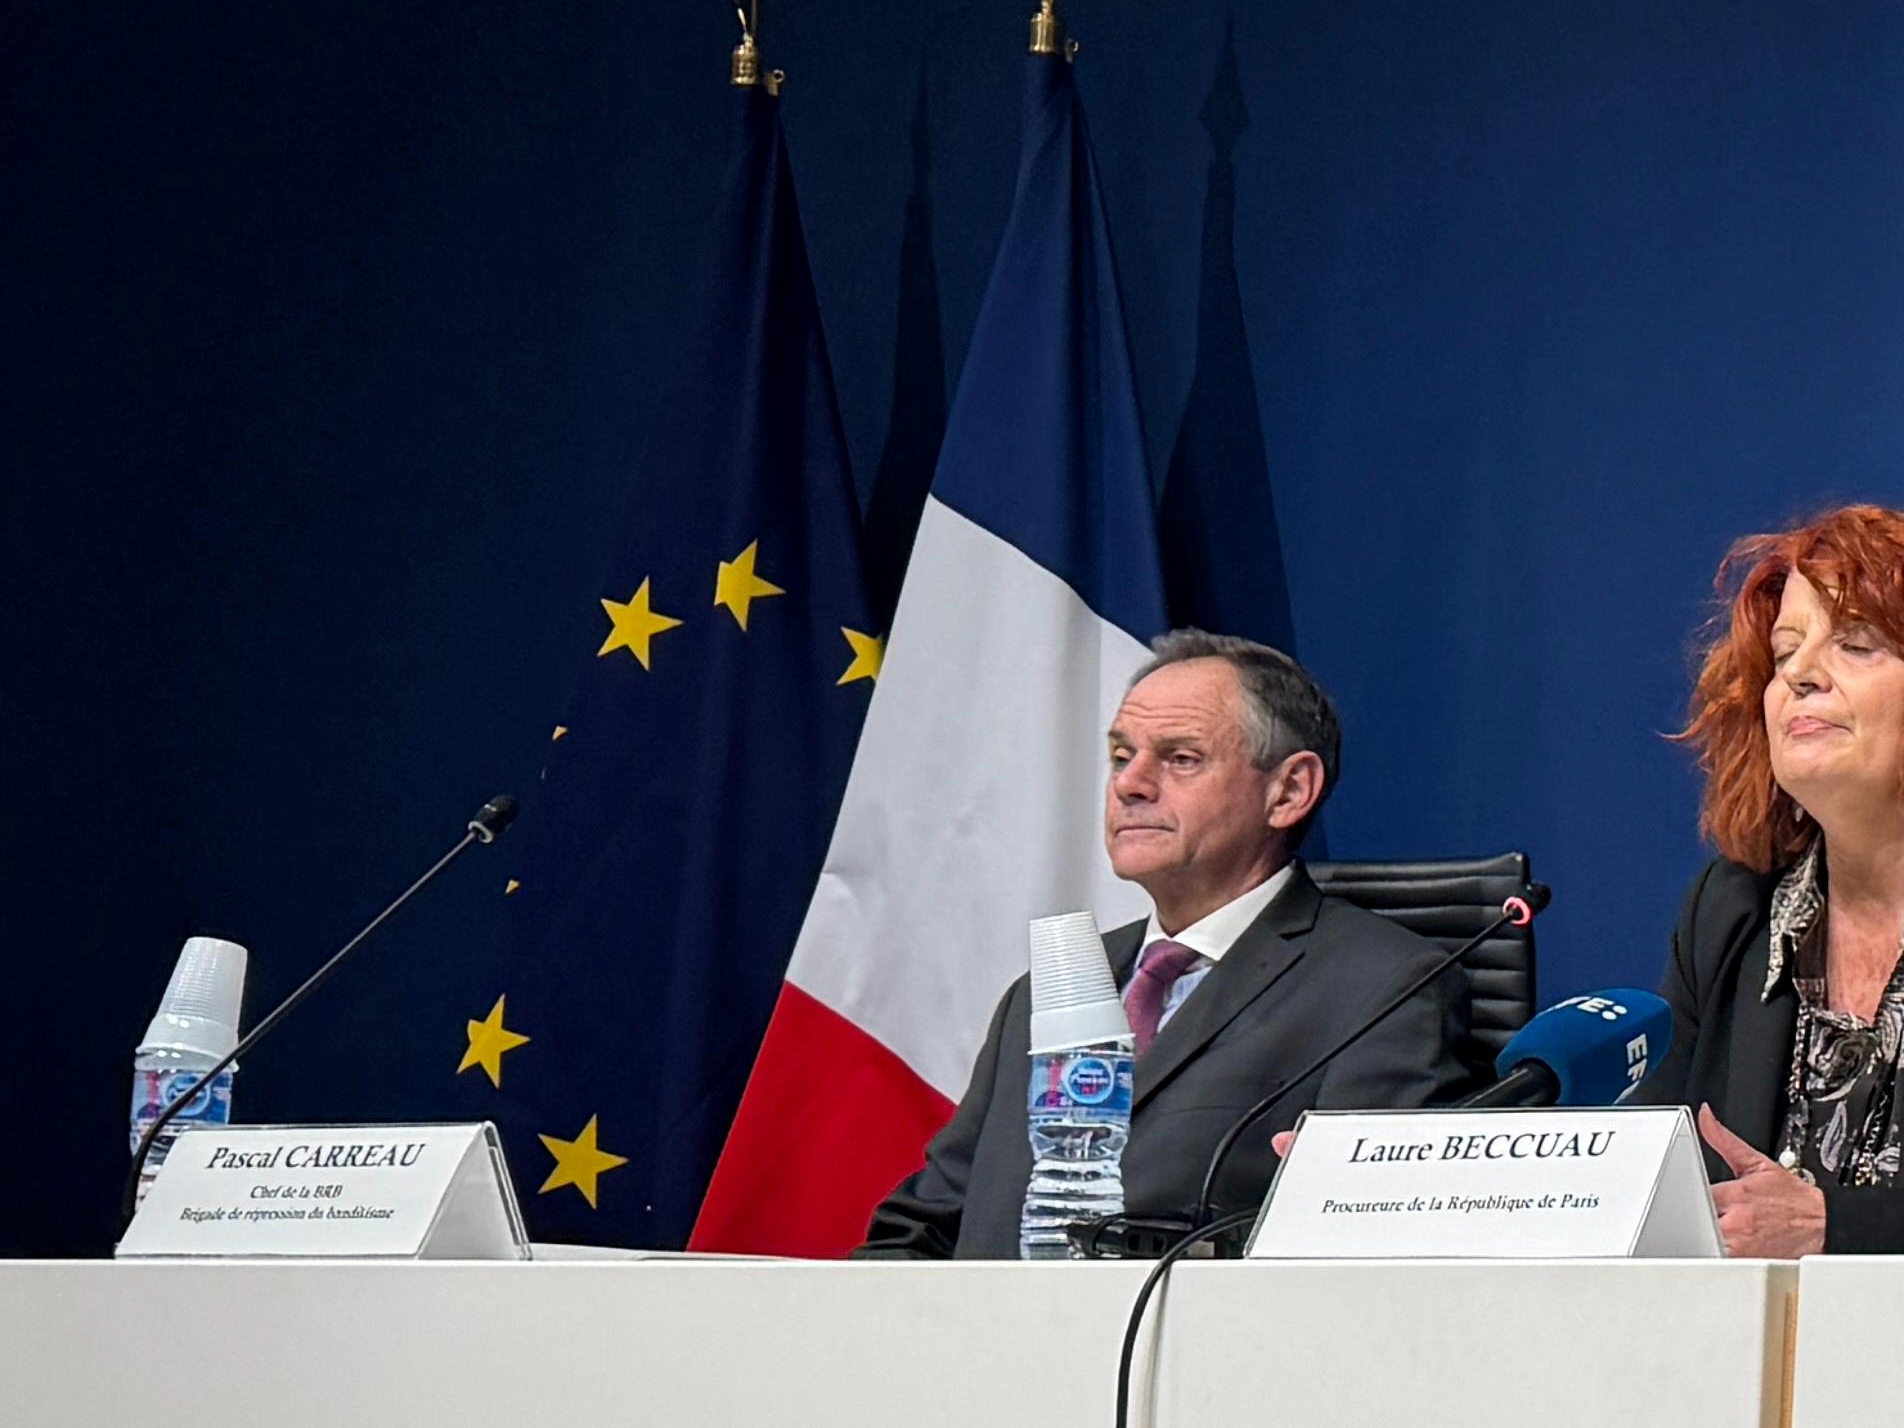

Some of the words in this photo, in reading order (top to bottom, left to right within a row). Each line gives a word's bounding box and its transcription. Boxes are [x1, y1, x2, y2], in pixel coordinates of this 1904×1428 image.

[206, 1146, 282, 1169] Pascal
[285, 1143, 426, 1168] CARREAU
[1348, 1138, 1433, 1163] Laure
[1438, 1131, 1616, 1161] BECCUAU
[250, 1185, 283, 1198] Chef
[281, 1186, 297, 1198] de
[227, 1207, 243, 1219] de
[1322, 1199, 1404, 1214] Procureure
[1407, 1197, 1426, 1212] de
[1428, 1196, 1442, 1211] la
[1447, 1195, 1533, 1214] République
[1537, 1194, 1556, 1209] de
[1560, 1193, 1600, 1209] Paris
